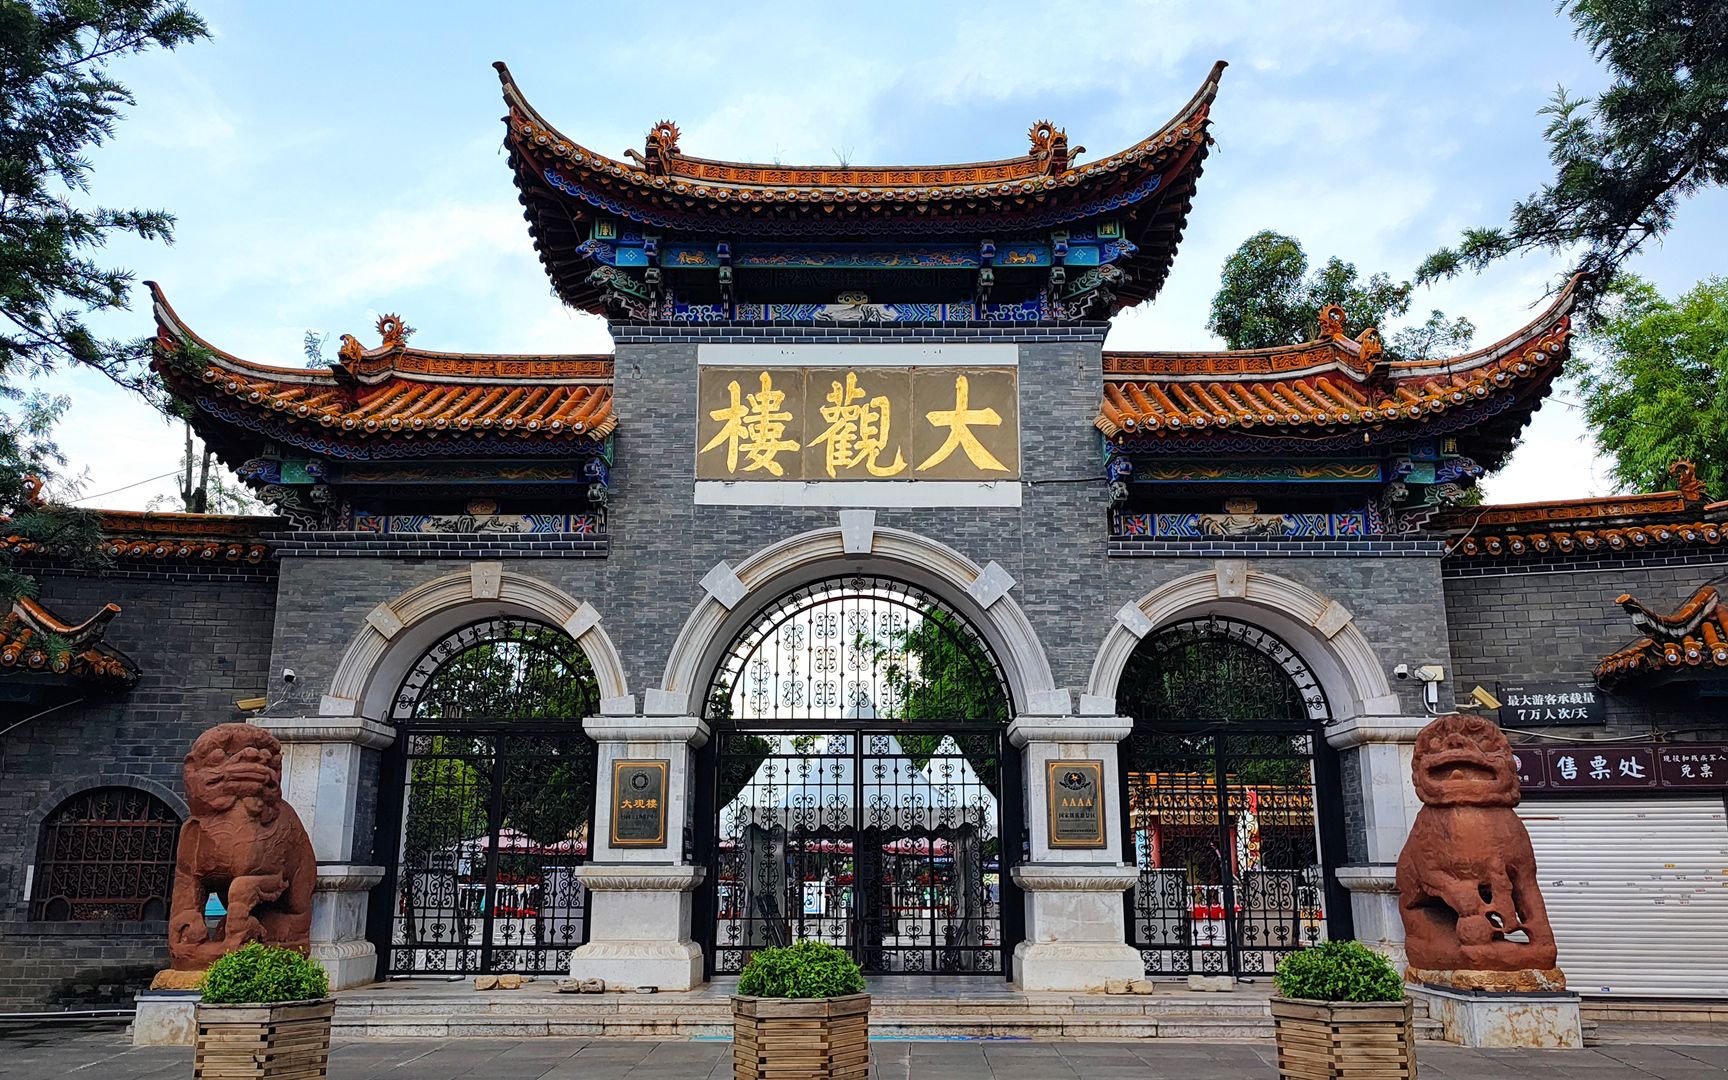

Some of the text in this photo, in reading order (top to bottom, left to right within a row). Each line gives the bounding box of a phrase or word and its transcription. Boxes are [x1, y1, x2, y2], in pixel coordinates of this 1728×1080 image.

[1507, 692, 1596, 707] 最大游客承载量
[1517, 707, 1589, 721] 7万人次/天
[1557, 755, 1647, 780] 售票处
[1681, 763, 1713, 778] 免票
[620, 799, 658, 809] 大观楼
[1061, 797, 1093, 807] AAAA
